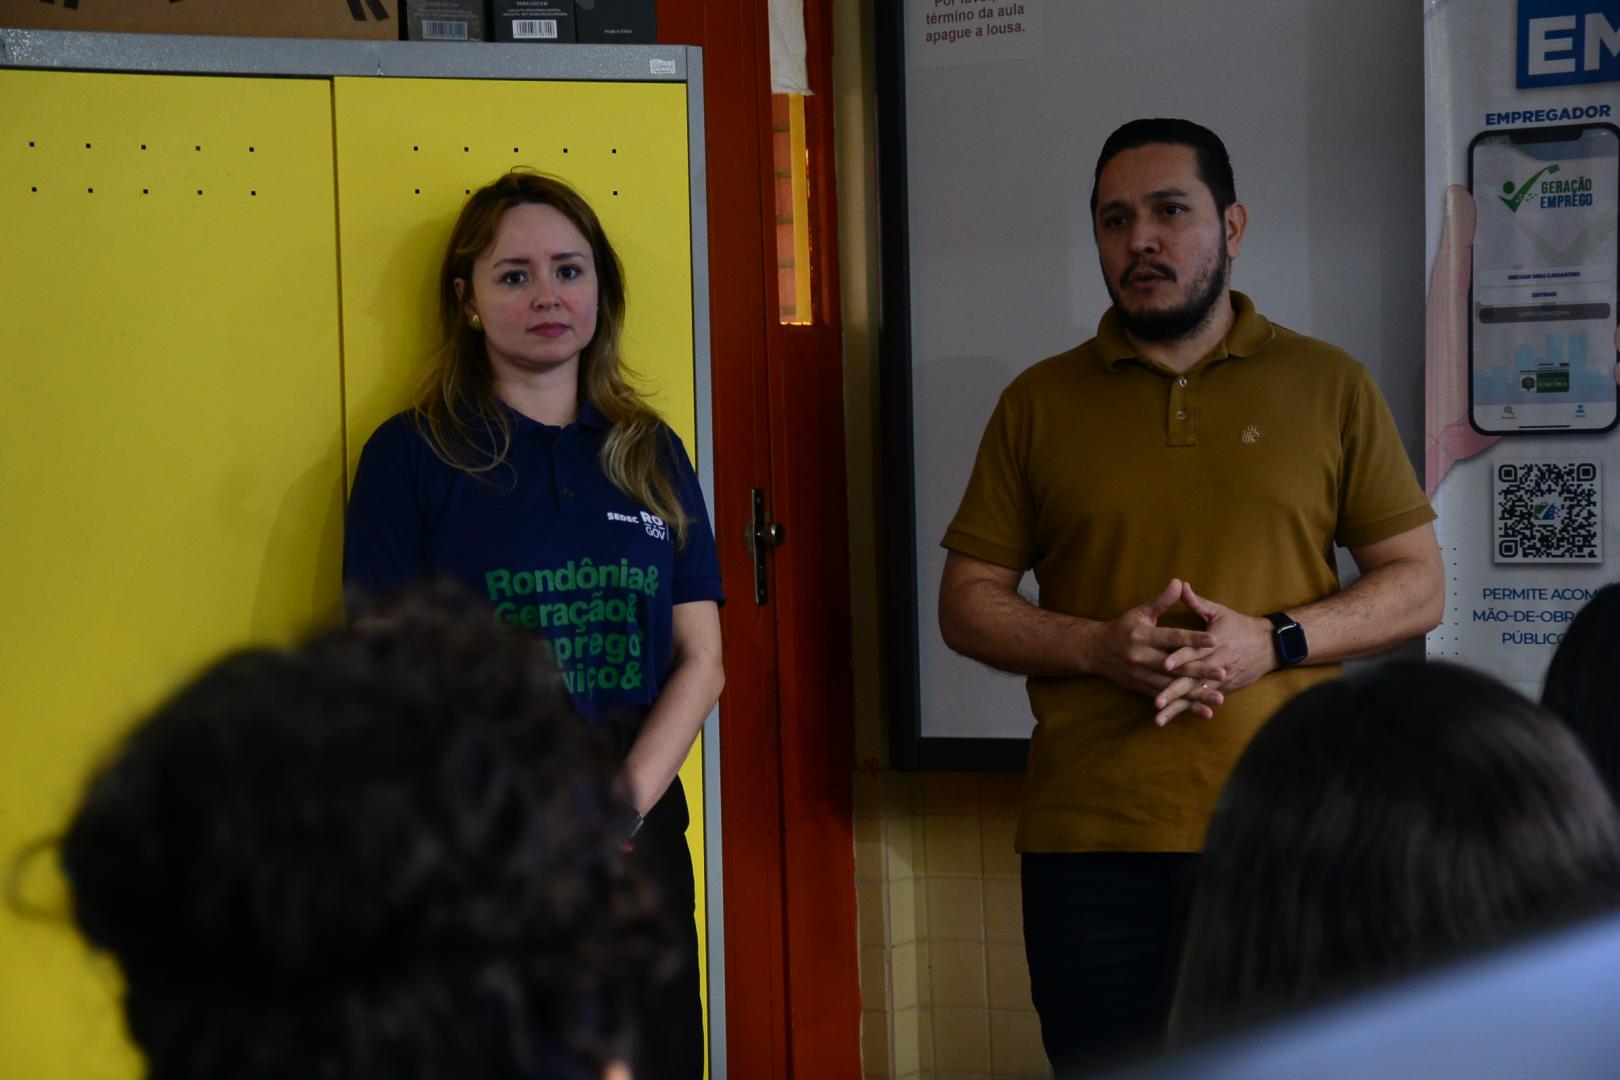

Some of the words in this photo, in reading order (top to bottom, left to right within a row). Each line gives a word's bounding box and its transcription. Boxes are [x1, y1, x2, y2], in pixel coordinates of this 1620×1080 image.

[926, 10, 975, 25] término
[978, 7, 993, 19] da
[997, 4, 1024, 17] aula
[926, 28, 972, 44] apague
[975, 27, 983, 37] a
[987, 23, 1025, 36] lousa.
[1485, 104, 1611, 126] EMPREGADOR
[1541, 177, 1592, 196] GERAÇÃO
[1540, 193, 1593, 209] EMPREGO
[640, 510, 664, 526] RO
[645, 526, 666, 541] GOV
[1482, 588, 1548, 601] PERMITE
